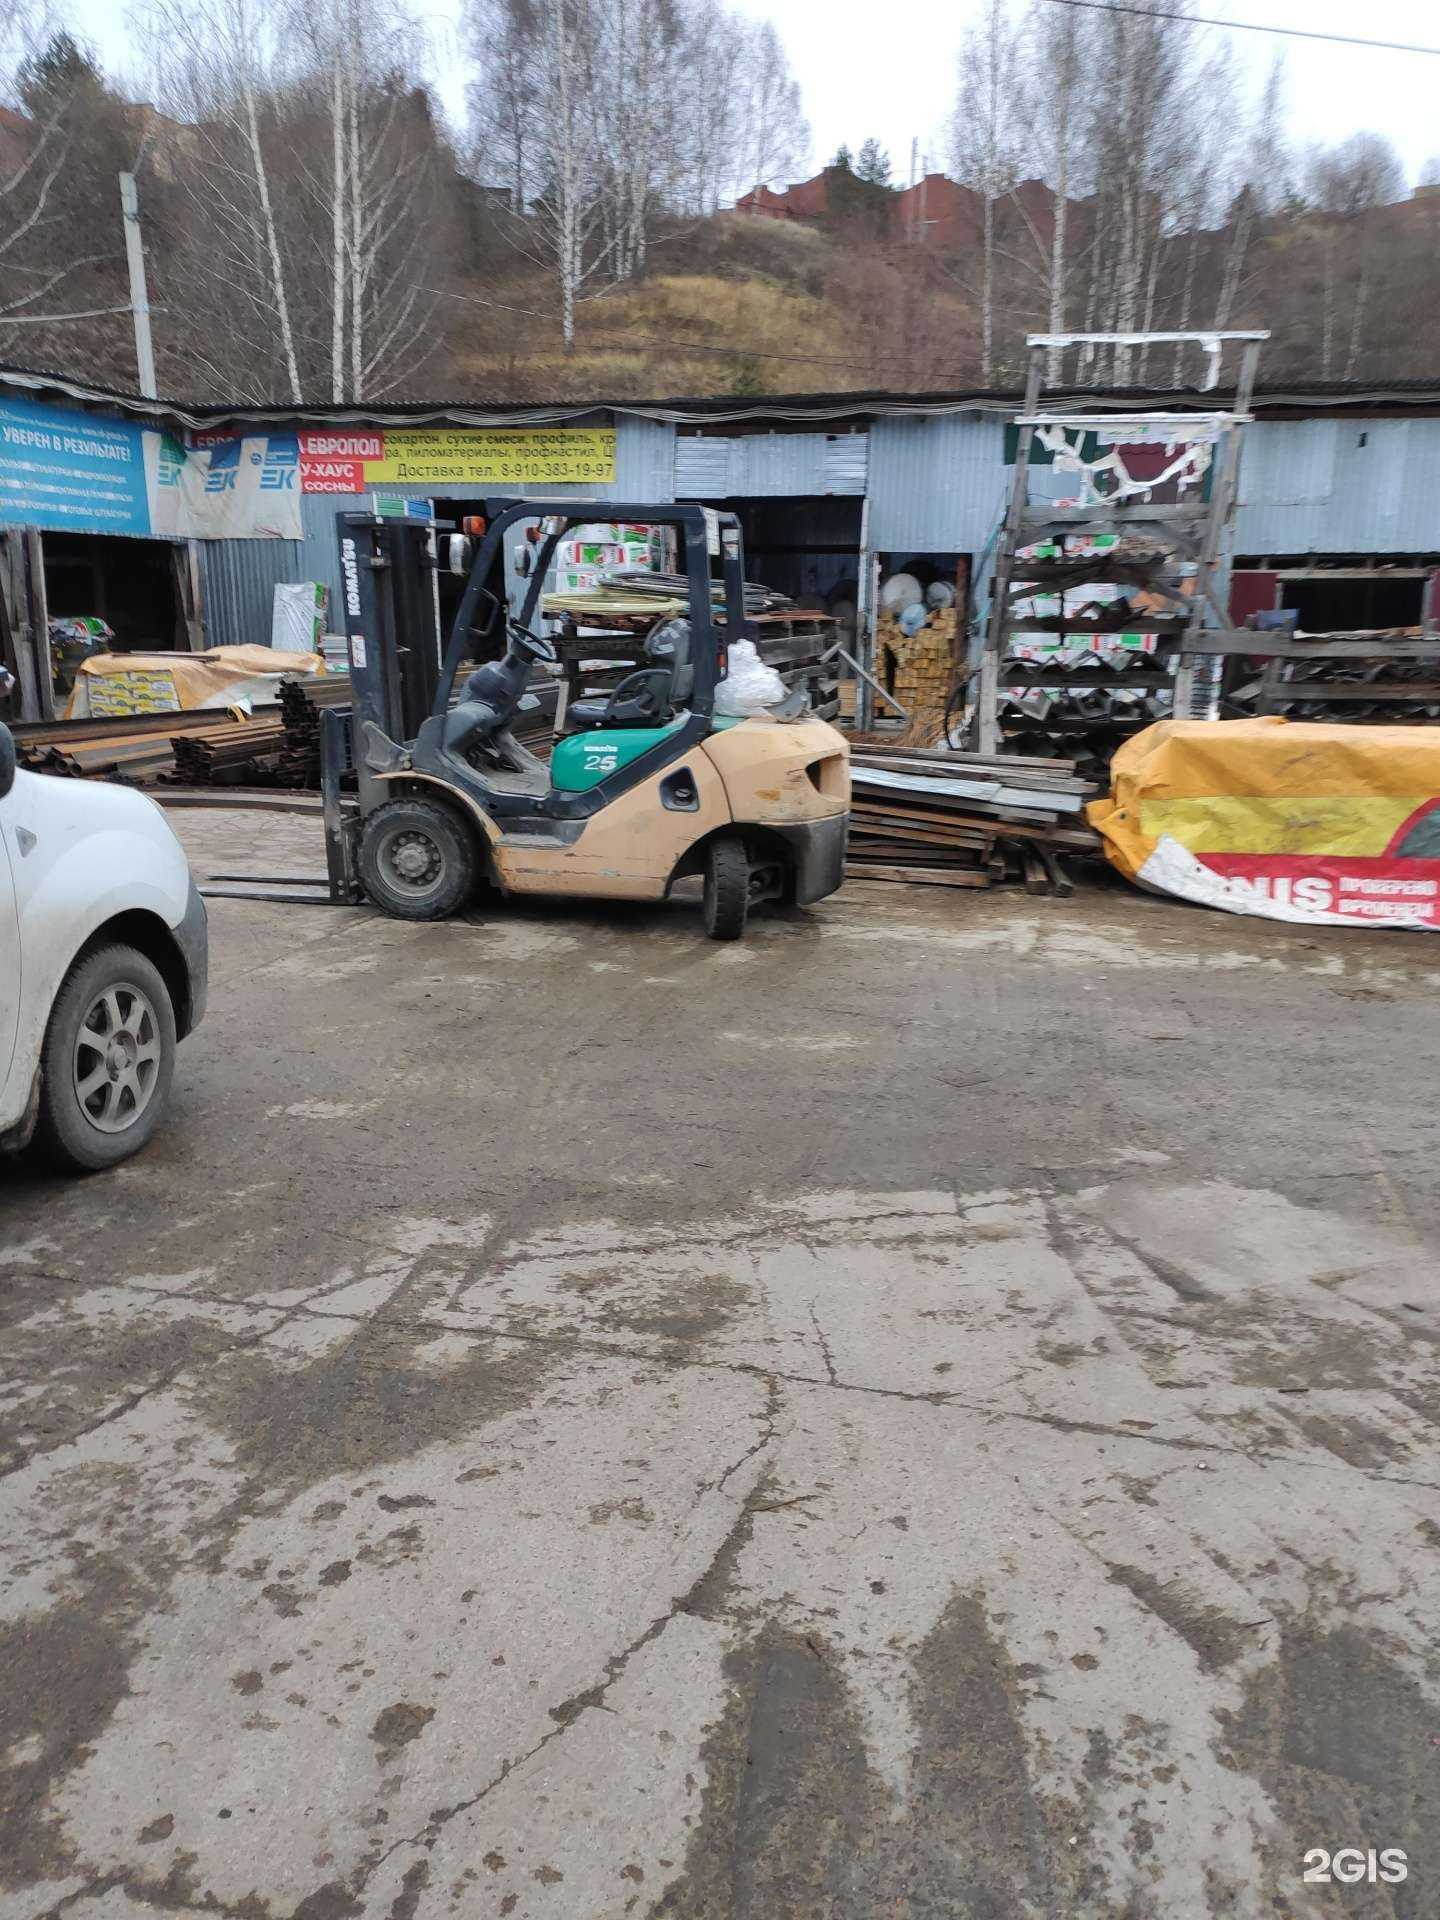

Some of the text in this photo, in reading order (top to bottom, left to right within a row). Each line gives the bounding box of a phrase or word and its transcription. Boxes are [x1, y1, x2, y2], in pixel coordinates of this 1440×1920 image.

[2, 425, 131, 463] УВЕРЕН В РЕЗУЛЬТАТЕ!
[307, 437, 380, 456] ЕВРОПОЛ
[447, 435, 482, 447] сухие
[397, 463, 464, 479] Доставка
[501, 463, 613, 477] 8-910-383-19-97
[304, 481, 356, 492] СОСНЫ
[584, 755, 618, 771] 25
